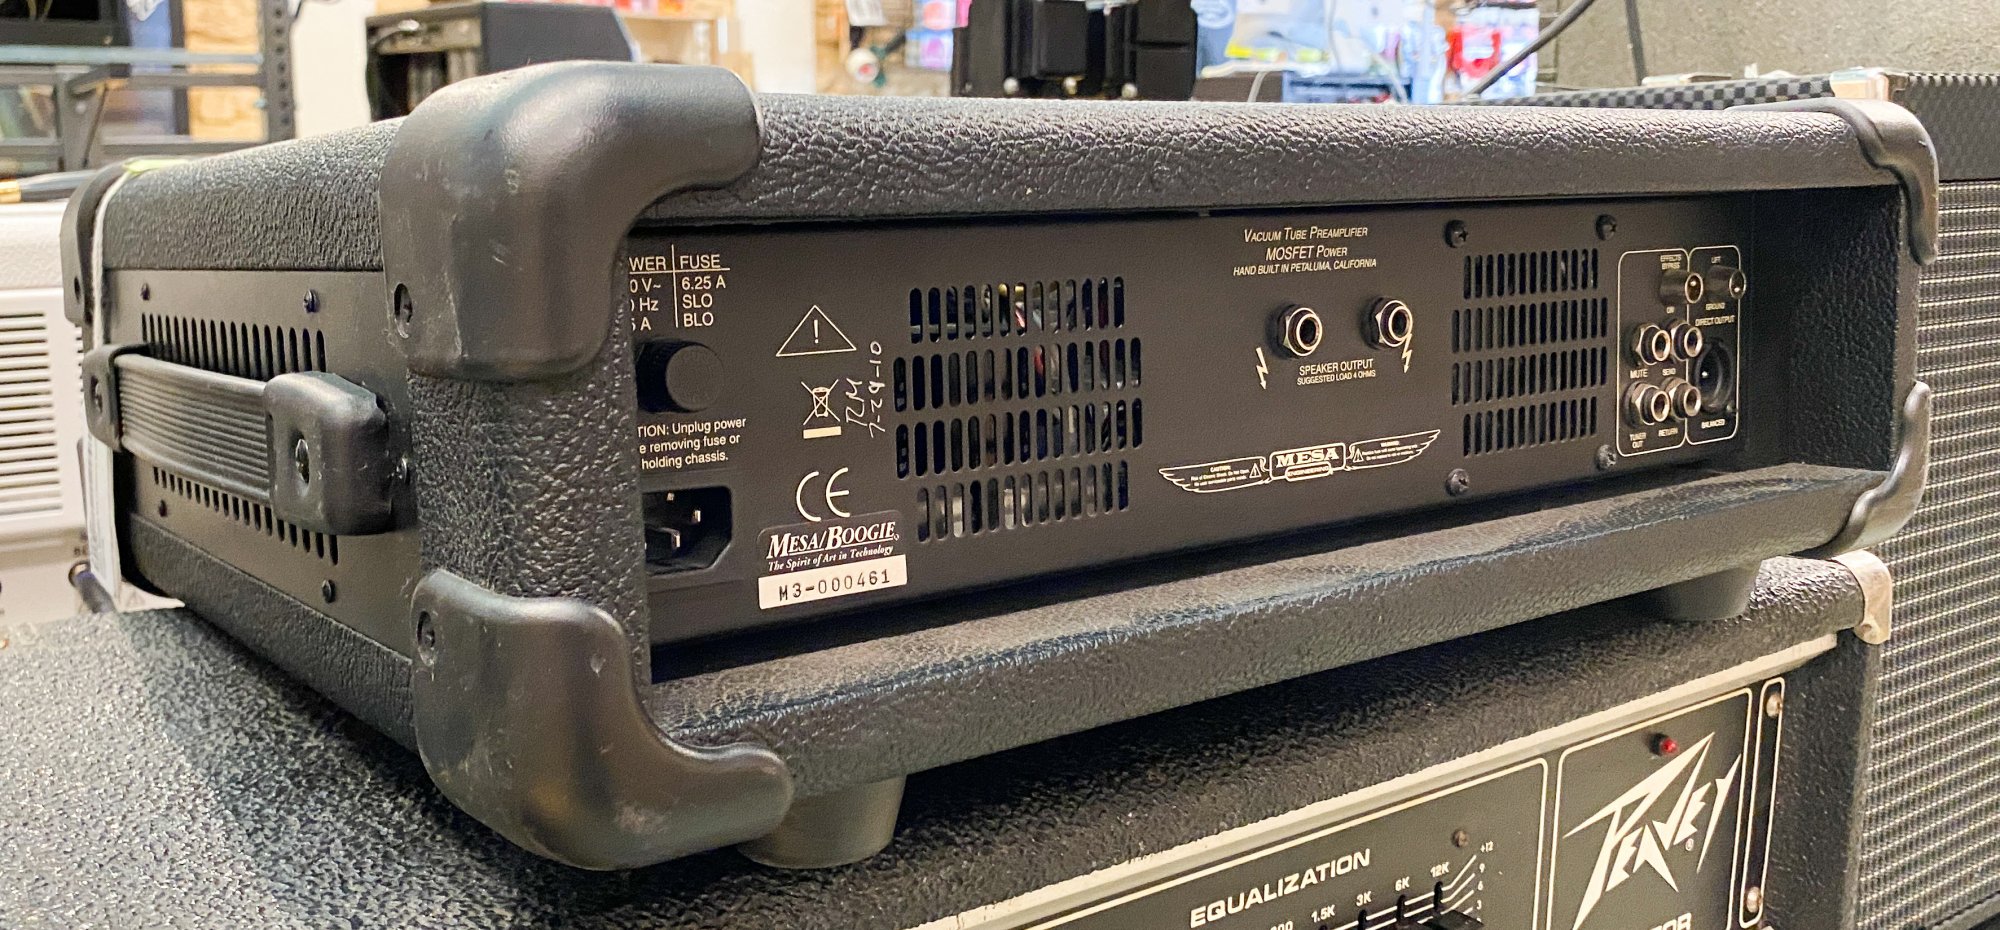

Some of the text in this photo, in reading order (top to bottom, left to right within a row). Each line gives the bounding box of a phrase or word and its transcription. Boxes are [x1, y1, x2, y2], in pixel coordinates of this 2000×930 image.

[1244, 225, 1368, 242] VACUUM TUBE PREAMPLIFIER
[1265, 244, 1347, 261] MOSFET POWER
[680, 254, 720, 269] FUSE
[1232, 265, 1256, 276] HAND
[1257, 263, 1280, 274] BUILT
[1280, 262, 1289, 273] IN
[1333, 258, 1377, 270] CALIFORNIA
[681, 274, 726, 291] 6.25 A
[639, 297, 659, 312] Hz
[682, 292, 713, 309] SLO
[640, 316, 651, 331] A
[683, 311, 714, 327] BLO
[1299, 358, 1374, 376] SPEAKER OUTPUT
[1630, 369, 1648, 379] MUTE
[1297, 374, 1335, 386] SUGGESTED
[1335, 372, 1352, 381] LOAD
[1357, 370, 1376, 379] OHMS
[672, 420, 711, 436] Unplug
[714, 418, 747, 433] power
[649, 438, 701, 453] removing
[703, 435, 726, 447] fuse
[729, 434, 741, 444] or
[641, 450, 729, 470] holding chassis.
[1276, 447, 1340, 468] MESA
[768, 545, 894, 572] The Spirit of Art in Technology
[778, 569, 890, 602] M3-000461
[1562, 731, 1742, 930] PEAVEY
[1430, 862, 1450, 877] 12K
[1190, 848, 1370, 929] EQUALIZATION
[1395, 876, 1410, 891] 6K
[1477, 880, 1484, 891] 6
[1356, 890, 1372, 907] 3K
[1476, 899, 1482, 910] 3
[1311, 904, 1336, 923] 1.5K
